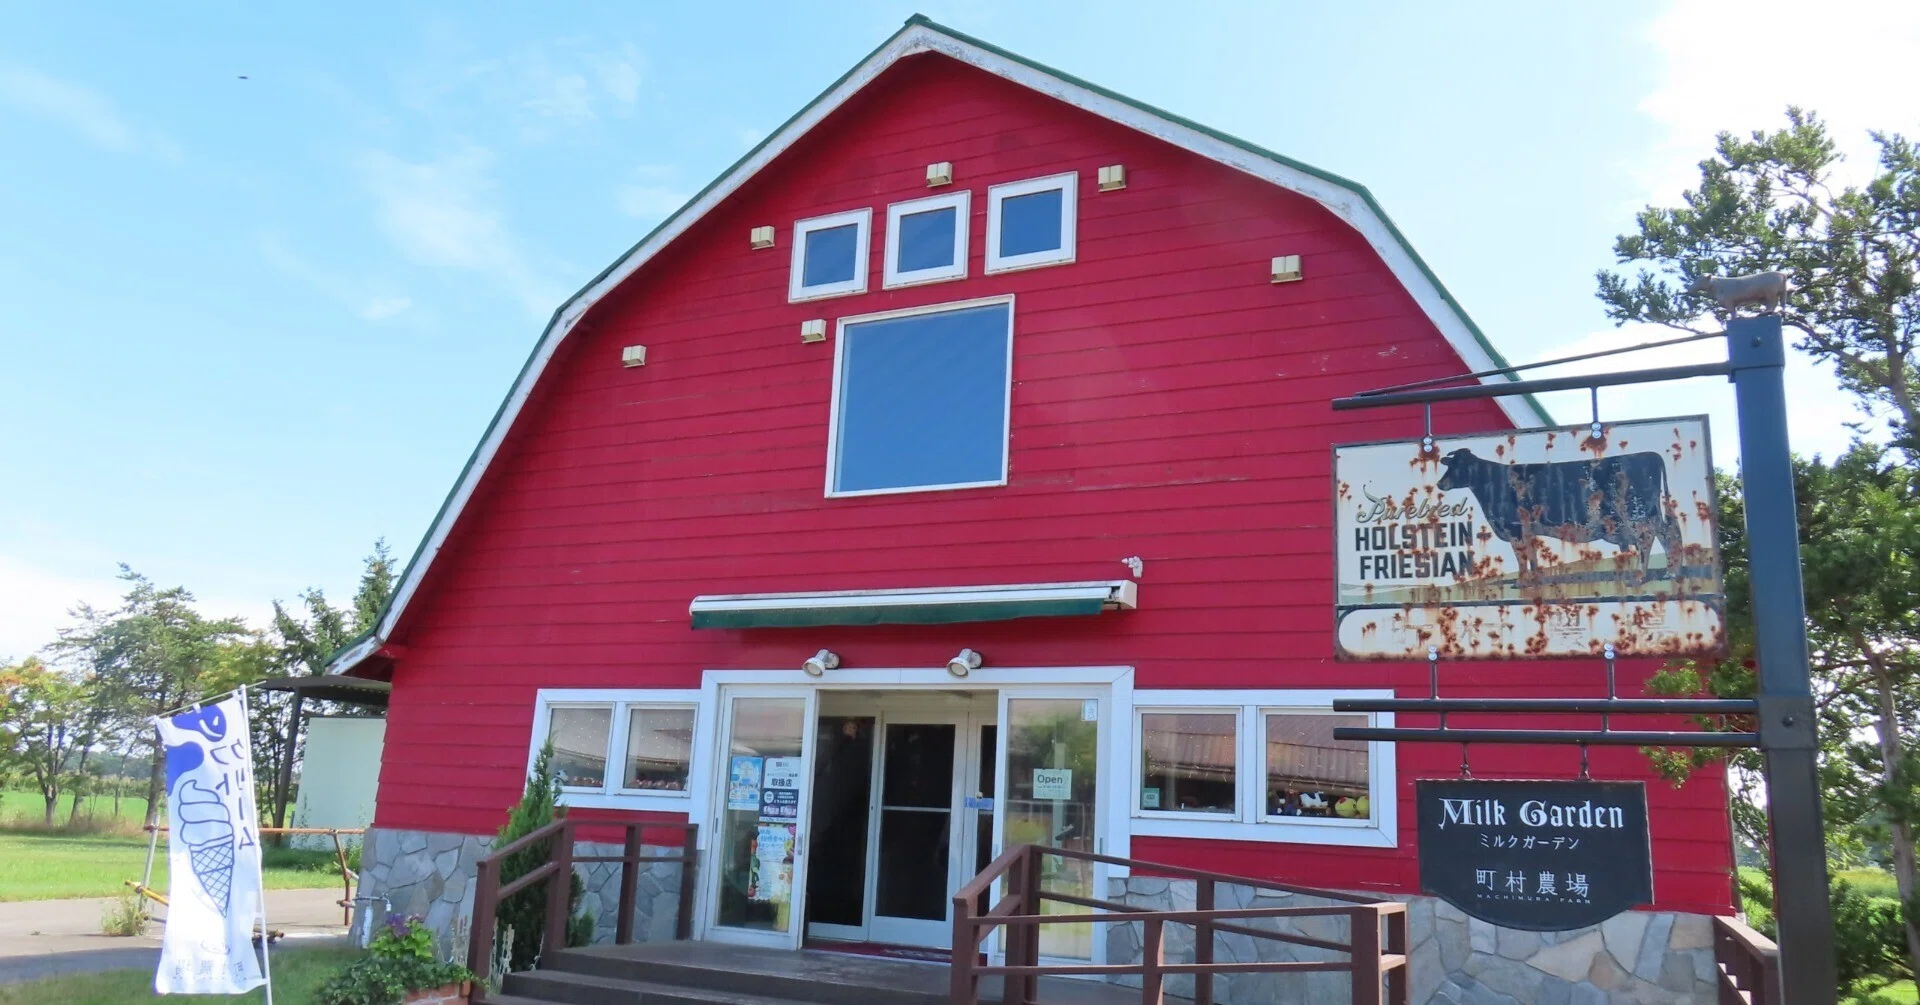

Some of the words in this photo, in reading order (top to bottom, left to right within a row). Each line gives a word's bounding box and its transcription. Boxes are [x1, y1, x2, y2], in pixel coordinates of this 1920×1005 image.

[1355, 484, 1468, 523] Purebred
[1355, 521, 1473, 552] HOLSTEIN
[1360, 551, 1474, 580] FRIESIAN
[1037, 774, 1063, 785] Open
[1438, 797, 1507, 831] Milk
[1519, 799, 1624, 829] Garden
[1480, 833, 1580, 850] ミルクガーデン
[1475, 868, 1590, 898] 町村農場
[1476, 893, 1550, 902] MACHIMURA
